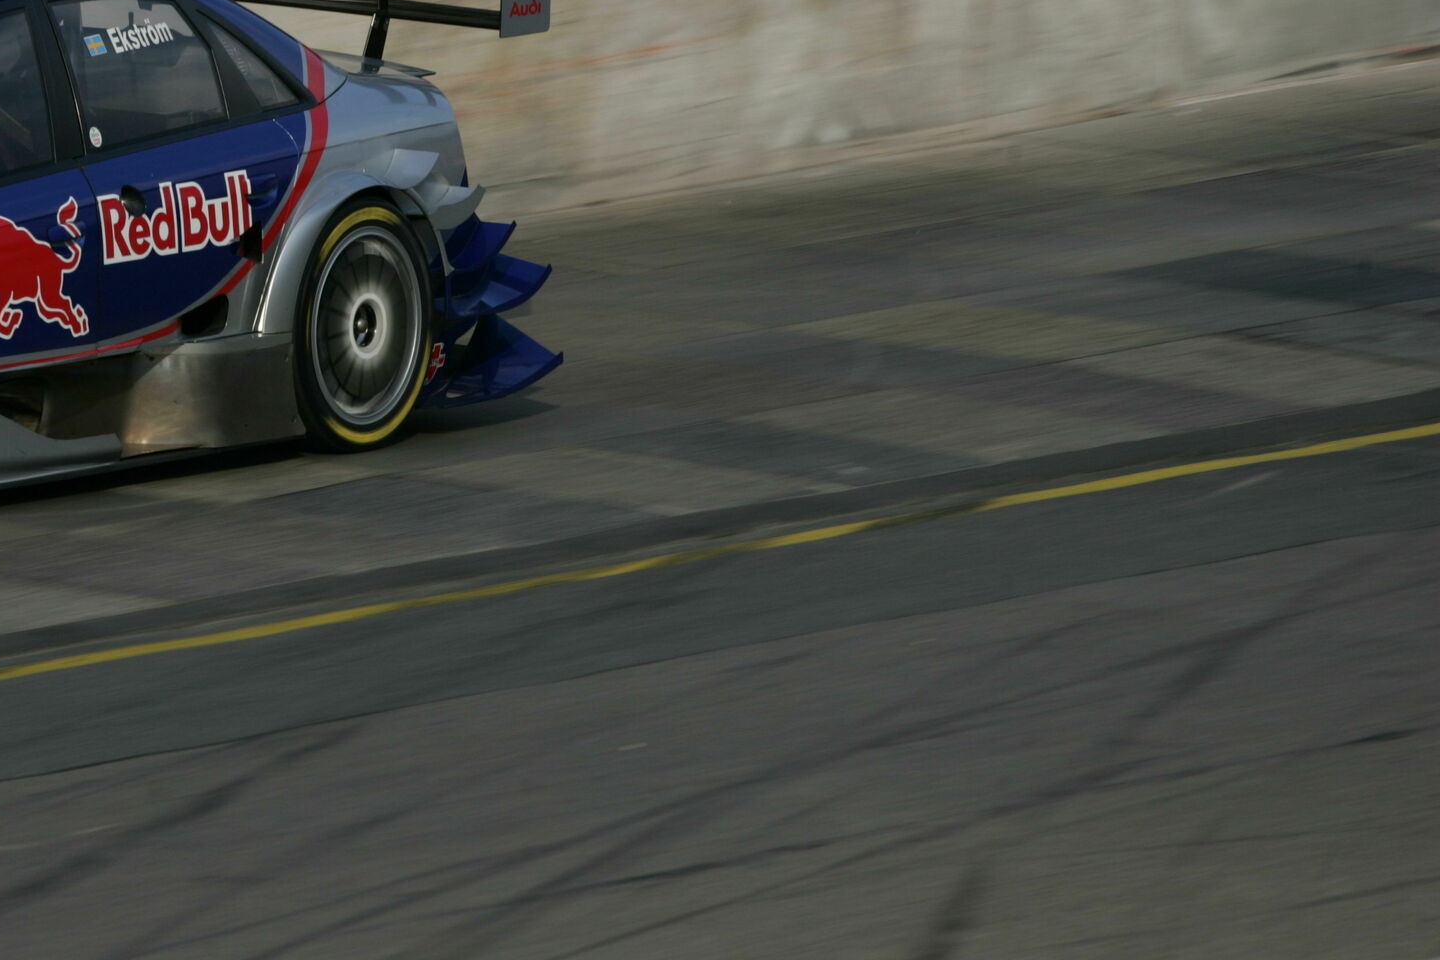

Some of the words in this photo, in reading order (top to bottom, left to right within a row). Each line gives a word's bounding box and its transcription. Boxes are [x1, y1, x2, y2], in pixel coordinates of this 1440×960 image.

[509, 0, 544, 18] Audi
[107, 17, 174, 54] Ekström
[99, 184, 177, 262] Red
[177, 172, 252, 249] Bull
